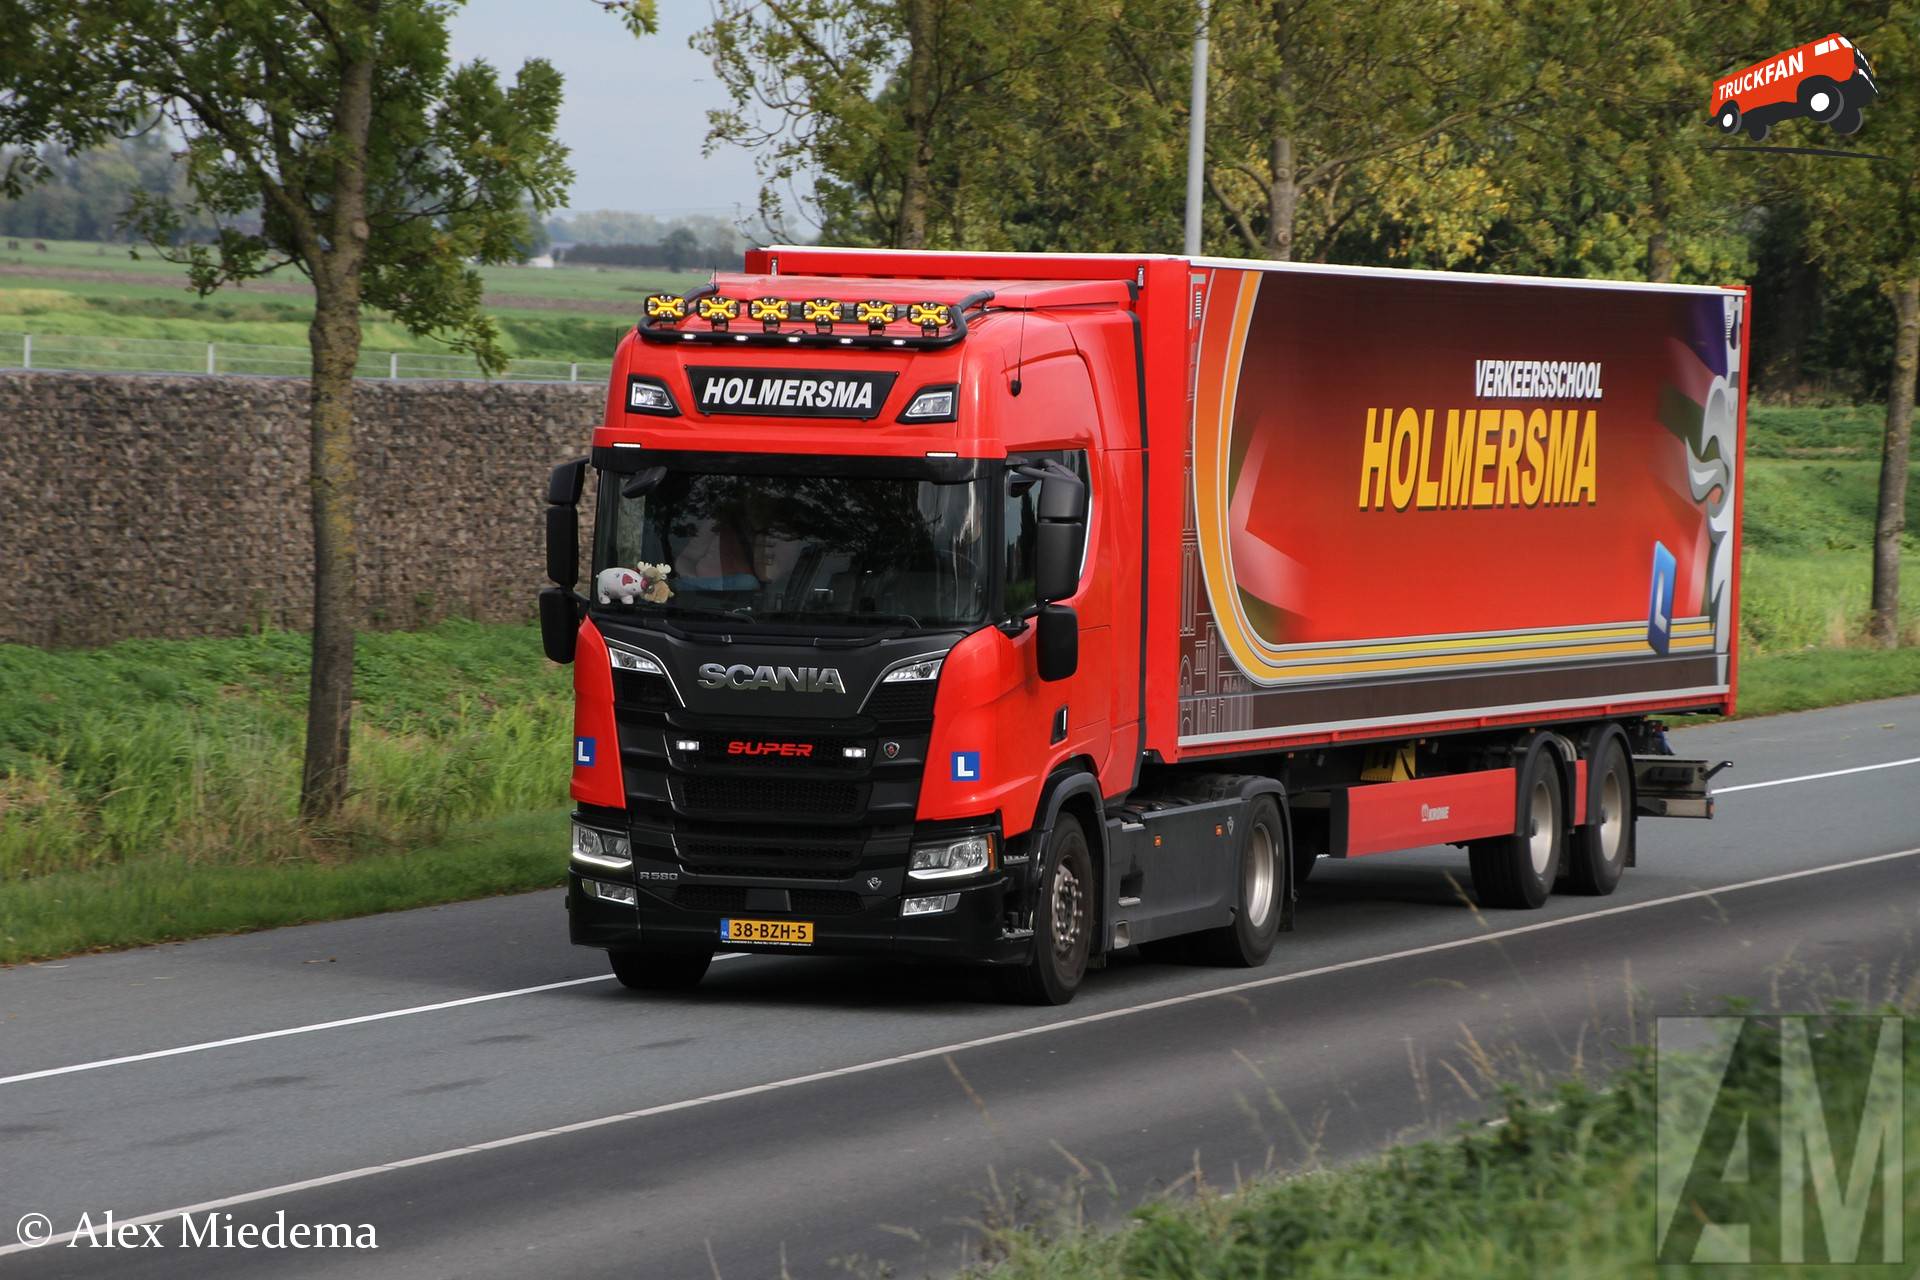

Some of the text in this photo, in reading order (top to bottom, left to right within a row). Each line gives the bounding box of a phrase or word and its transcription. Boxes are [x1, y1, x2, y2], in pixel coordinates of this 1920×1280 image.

[1475, 359, 1603, 400] VERKEERSSCHOOL
[702, 377, 873, 409] HOLMERSMA
[1359, 407, 1598, 510] HOLMERSMA
[697, 663, 846, 694] SCANIA
[578, 741, 590, 761] L
[727, 741, 813, 757] SUPER
[957, 756, 974, 777] L
[733, 922, 807, 940] 38-BZH-5
